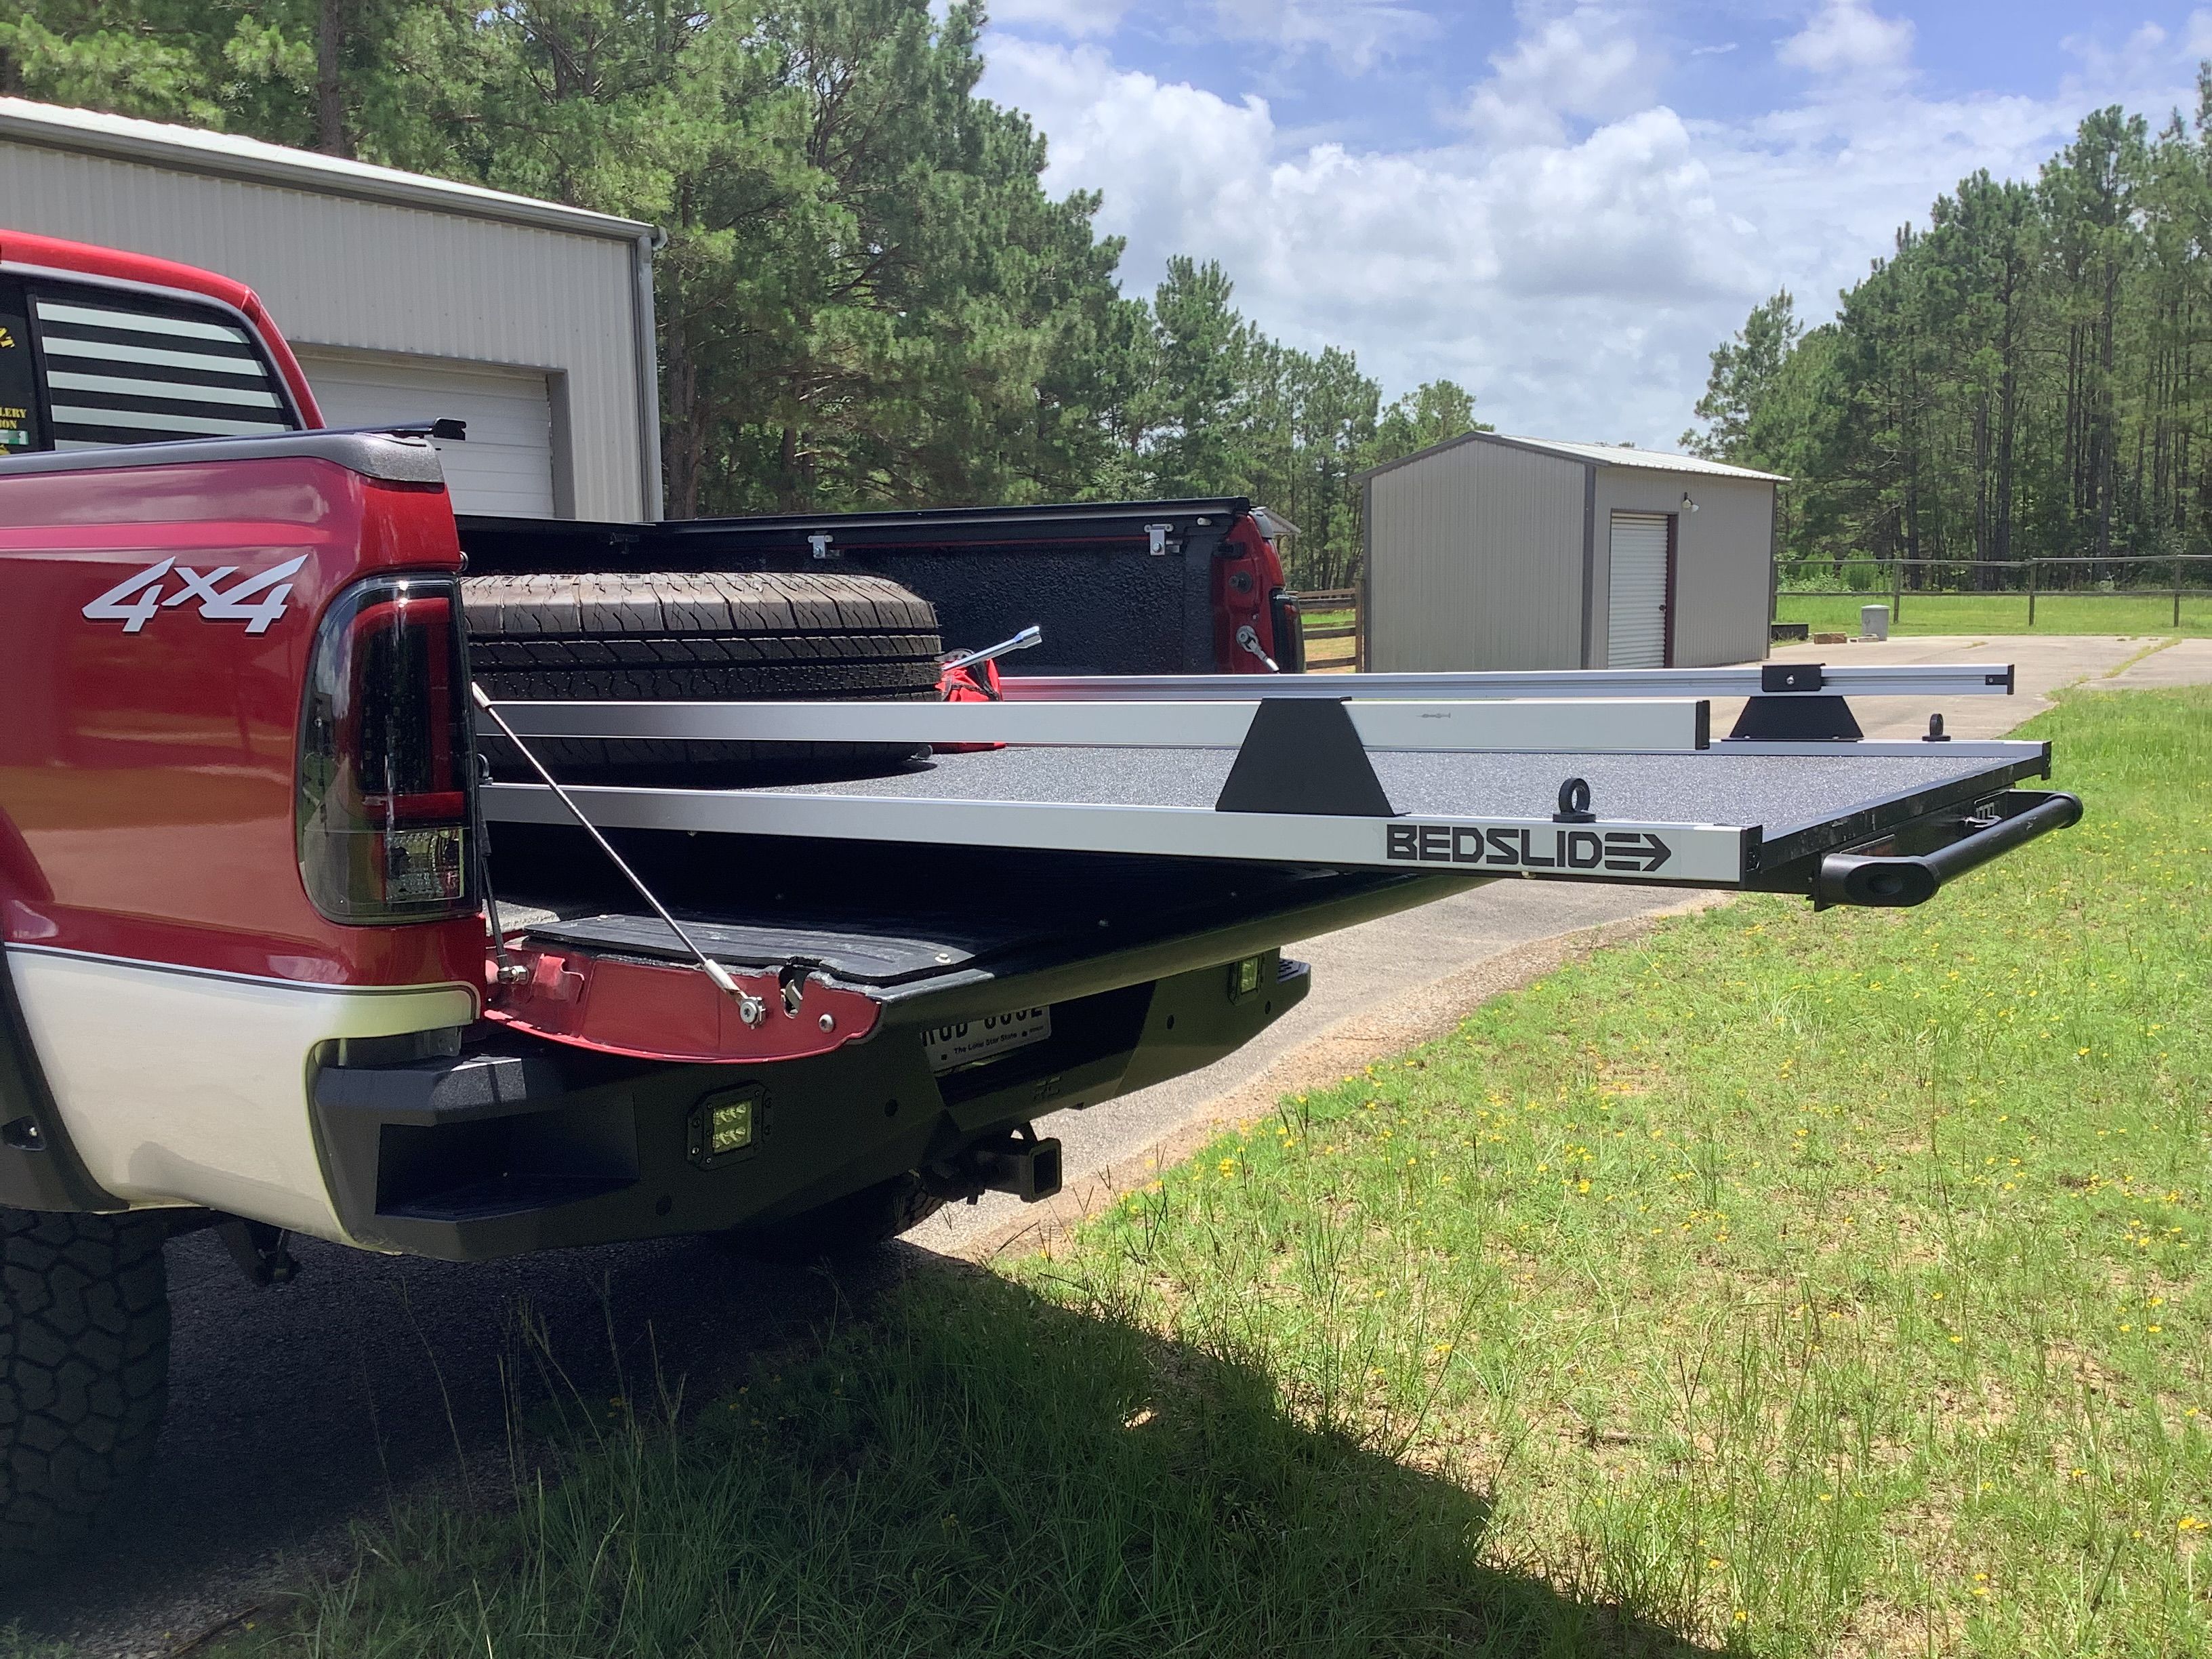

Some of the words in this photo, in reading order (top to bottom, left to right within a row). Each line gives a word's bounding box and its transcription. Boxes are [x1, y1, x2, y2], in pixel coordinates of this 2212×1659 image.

[1387, 824, 1671, 872] BEDSLIDE
[968, 1042, 985, 1051] Lone
[986, 1038, 999, 1046] Star
[1001, 1033, 1017, 1041] State
